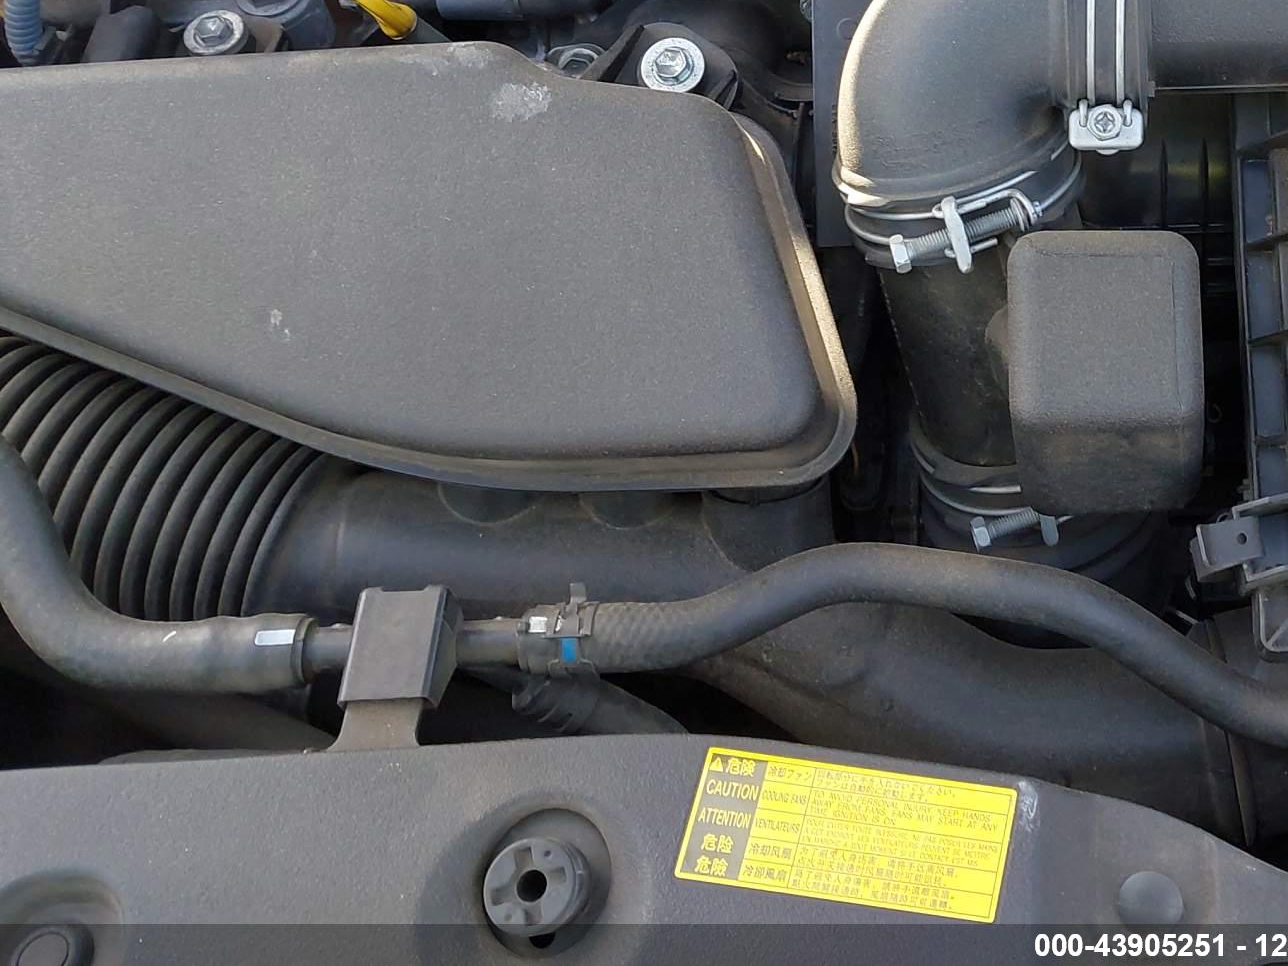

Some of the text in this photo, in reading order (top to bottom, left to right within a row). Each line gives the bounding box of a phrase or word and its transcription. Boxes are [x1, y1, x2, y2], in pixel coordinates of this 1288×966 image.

[704, 778, 760, 801] CAUTION
[760, 789, 807, 806] COOLING FANS
[696, 805, 752, 829] ATTENTION
